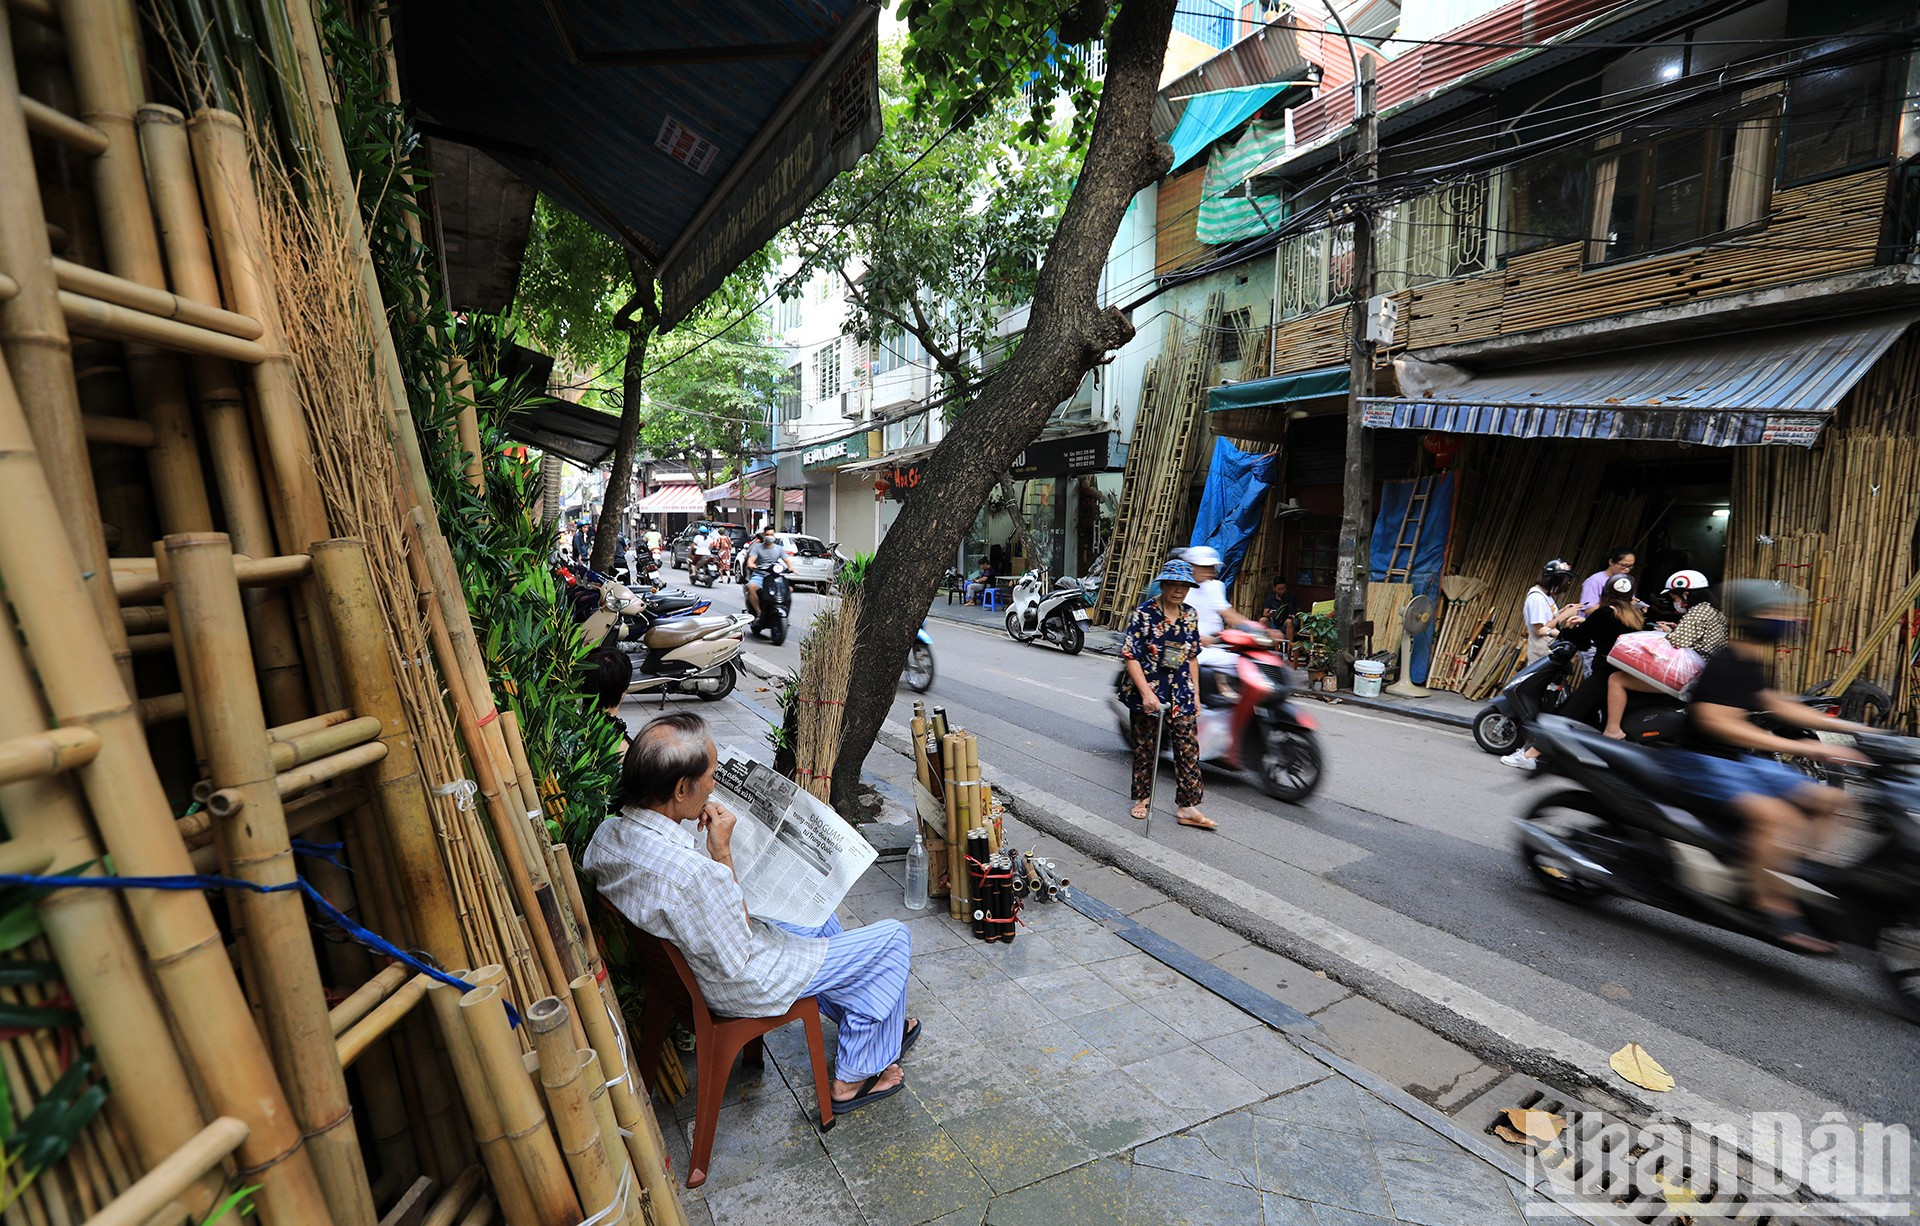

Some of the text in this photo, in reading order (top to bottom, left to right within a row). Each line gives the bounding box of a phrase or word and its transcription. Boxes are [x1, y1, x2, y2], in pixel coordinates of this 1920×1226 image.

[792, 812, 806, 824] trong
[809, 813, 844, 843] ĐẢO GUAM
[808, 833, 821, 847] Trung
[820, 843, 833, 855] Quốc
